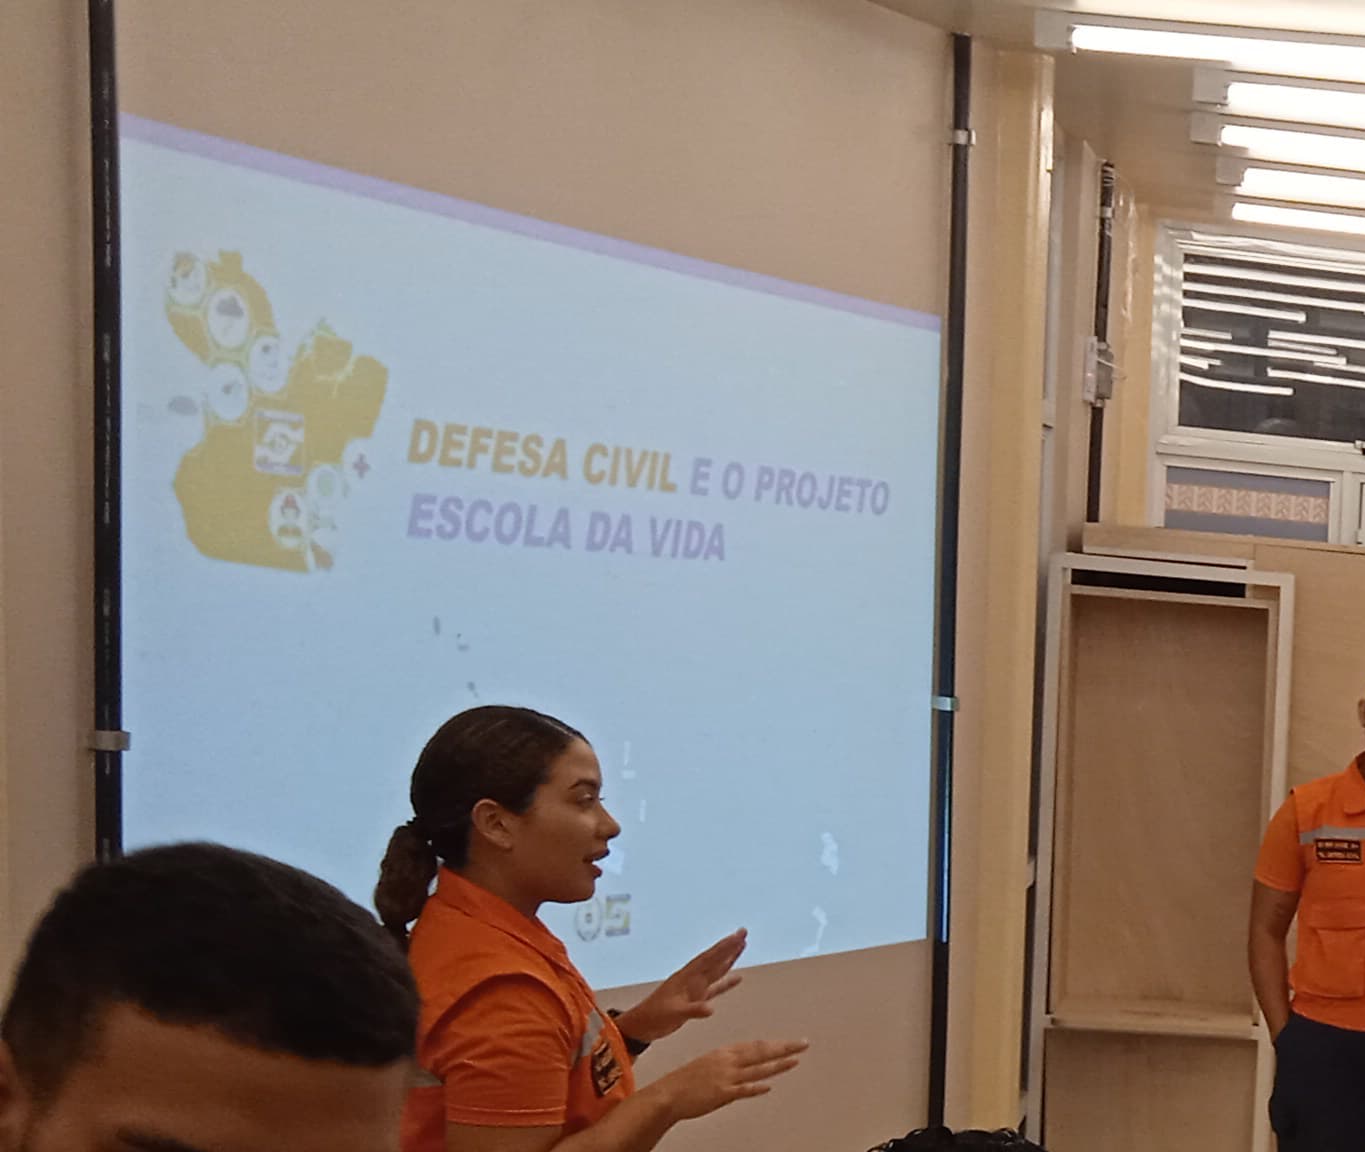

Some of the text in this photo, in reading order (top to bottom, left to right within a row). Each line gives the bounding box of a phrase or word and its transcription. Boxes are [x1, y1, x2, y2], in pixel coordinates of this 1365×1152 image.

[407, 418, 890, 516] DEFESA CIVIL E O PROJETO
[406, 494, 727, 560] ESCOLA DA VIDA
